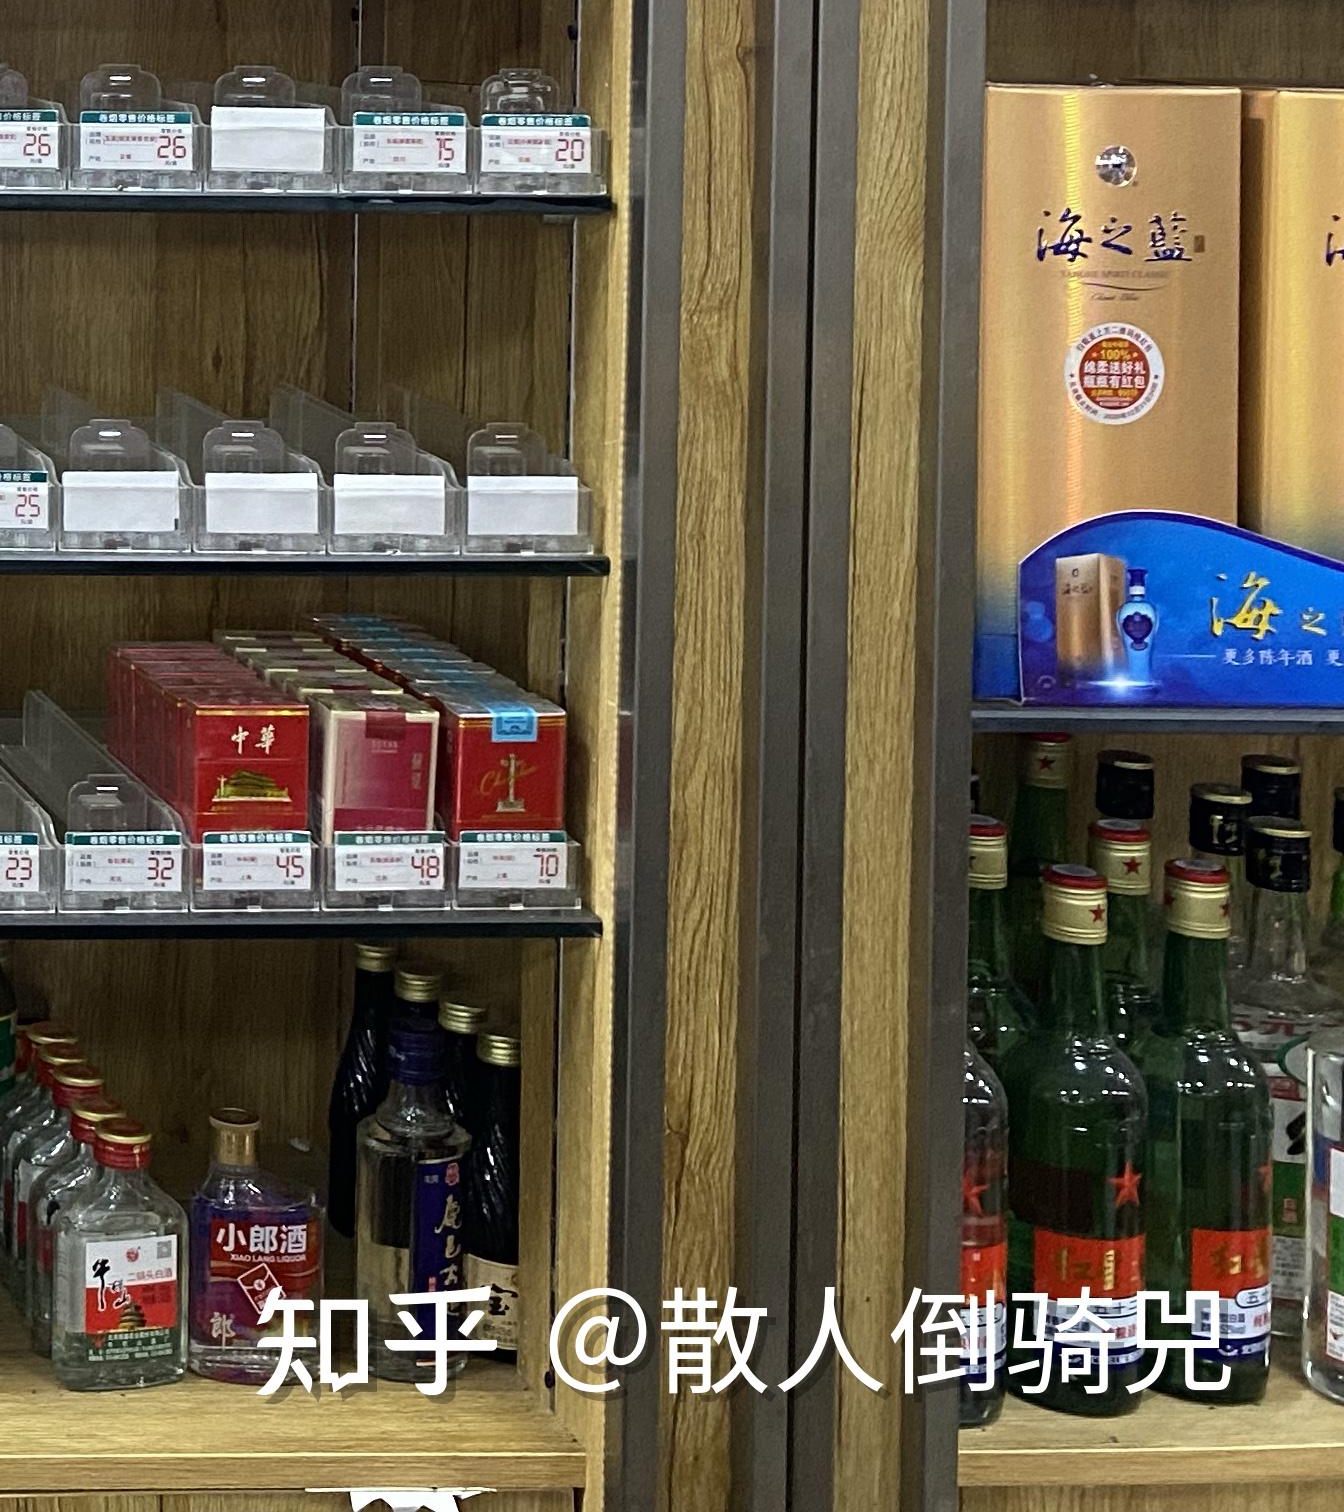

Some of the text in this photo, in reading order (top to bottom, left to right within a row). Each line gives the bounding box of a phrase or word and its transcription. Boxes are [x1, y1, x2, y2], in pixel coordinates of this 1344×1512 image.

[156, 135, 187, 159] 26
[15, 494, 41, 518] 25
[147, 857, 175, 881] 32
[276, 856, 305, 880] 45
[533, 853, 559, 878] 70
[216, 1224, 307, 1255] 小郎酒
